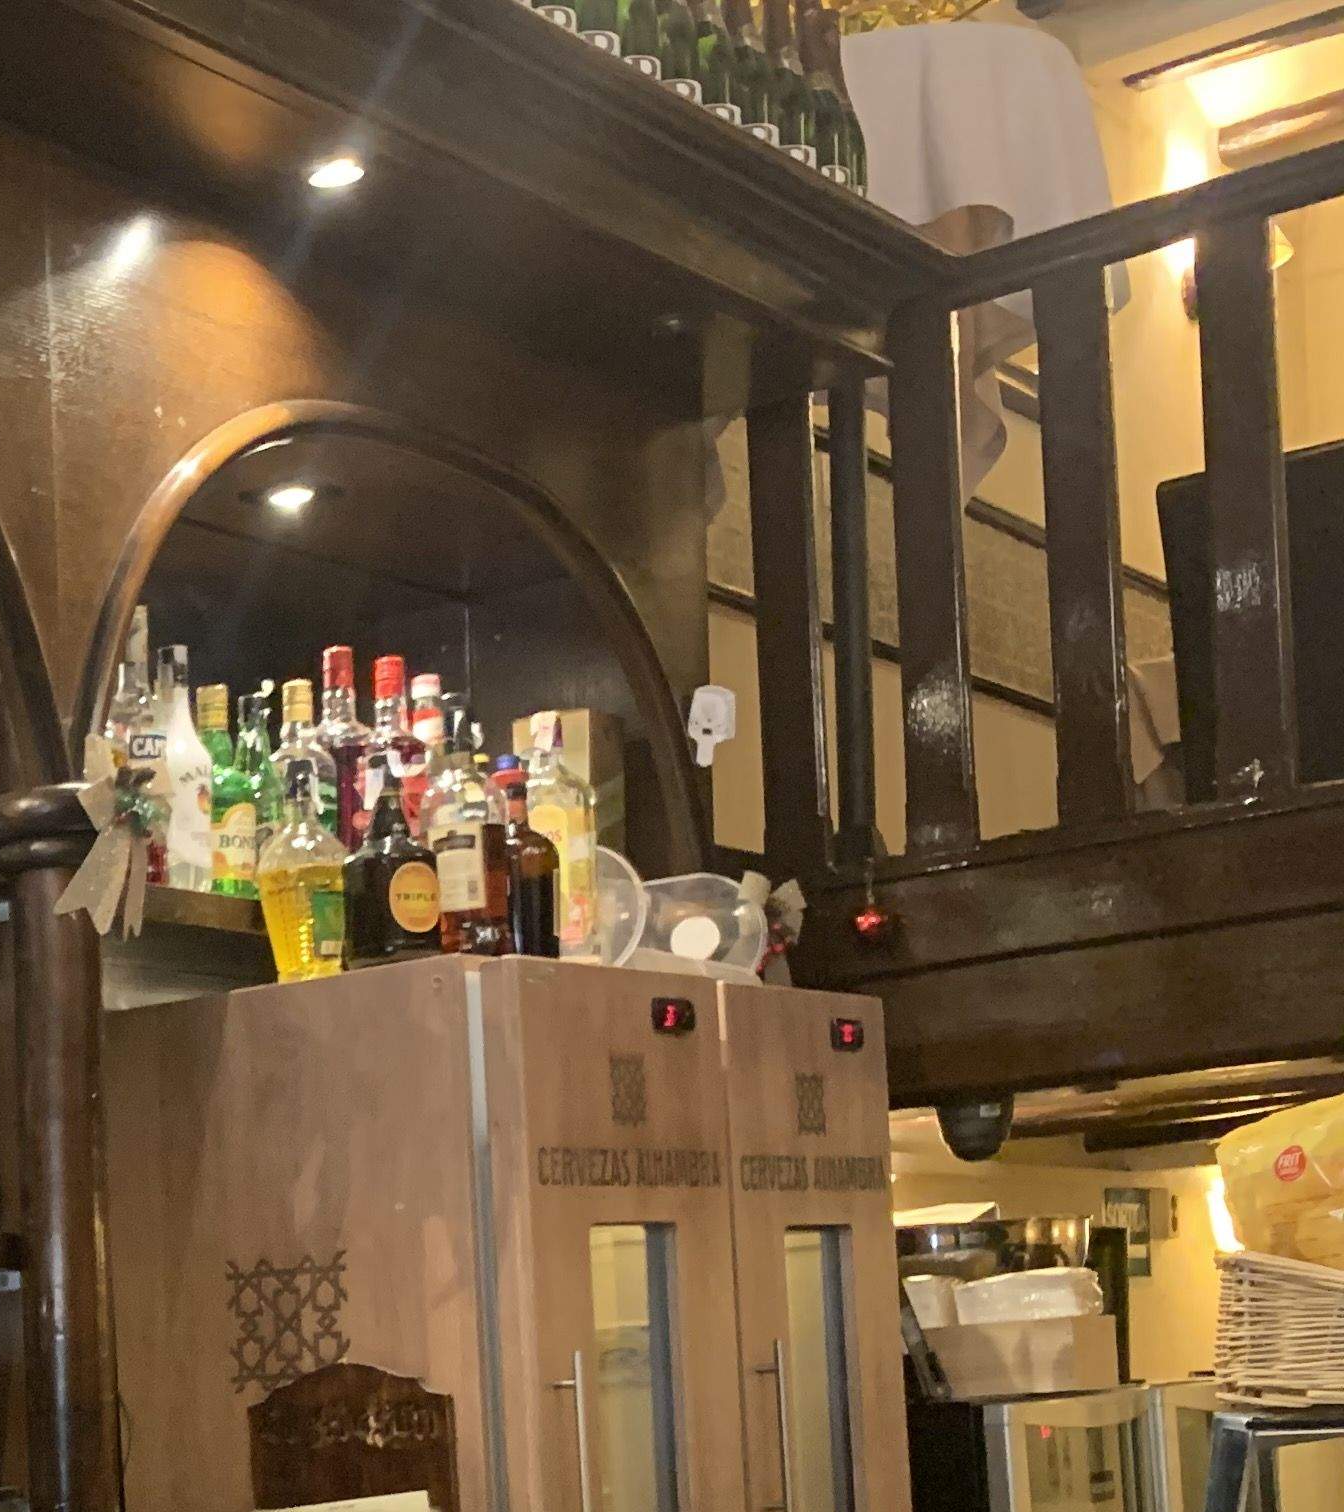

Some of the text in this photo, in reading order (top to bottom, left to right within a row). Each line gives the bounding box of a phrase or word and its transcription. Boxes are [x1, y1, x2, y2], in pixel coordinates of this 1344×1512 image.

[537, 1146, 723, 1188] CERVEZAS ALHAMBRA
[740, 1154, 888, 1192] CERVEZAS ALHAMBRA
